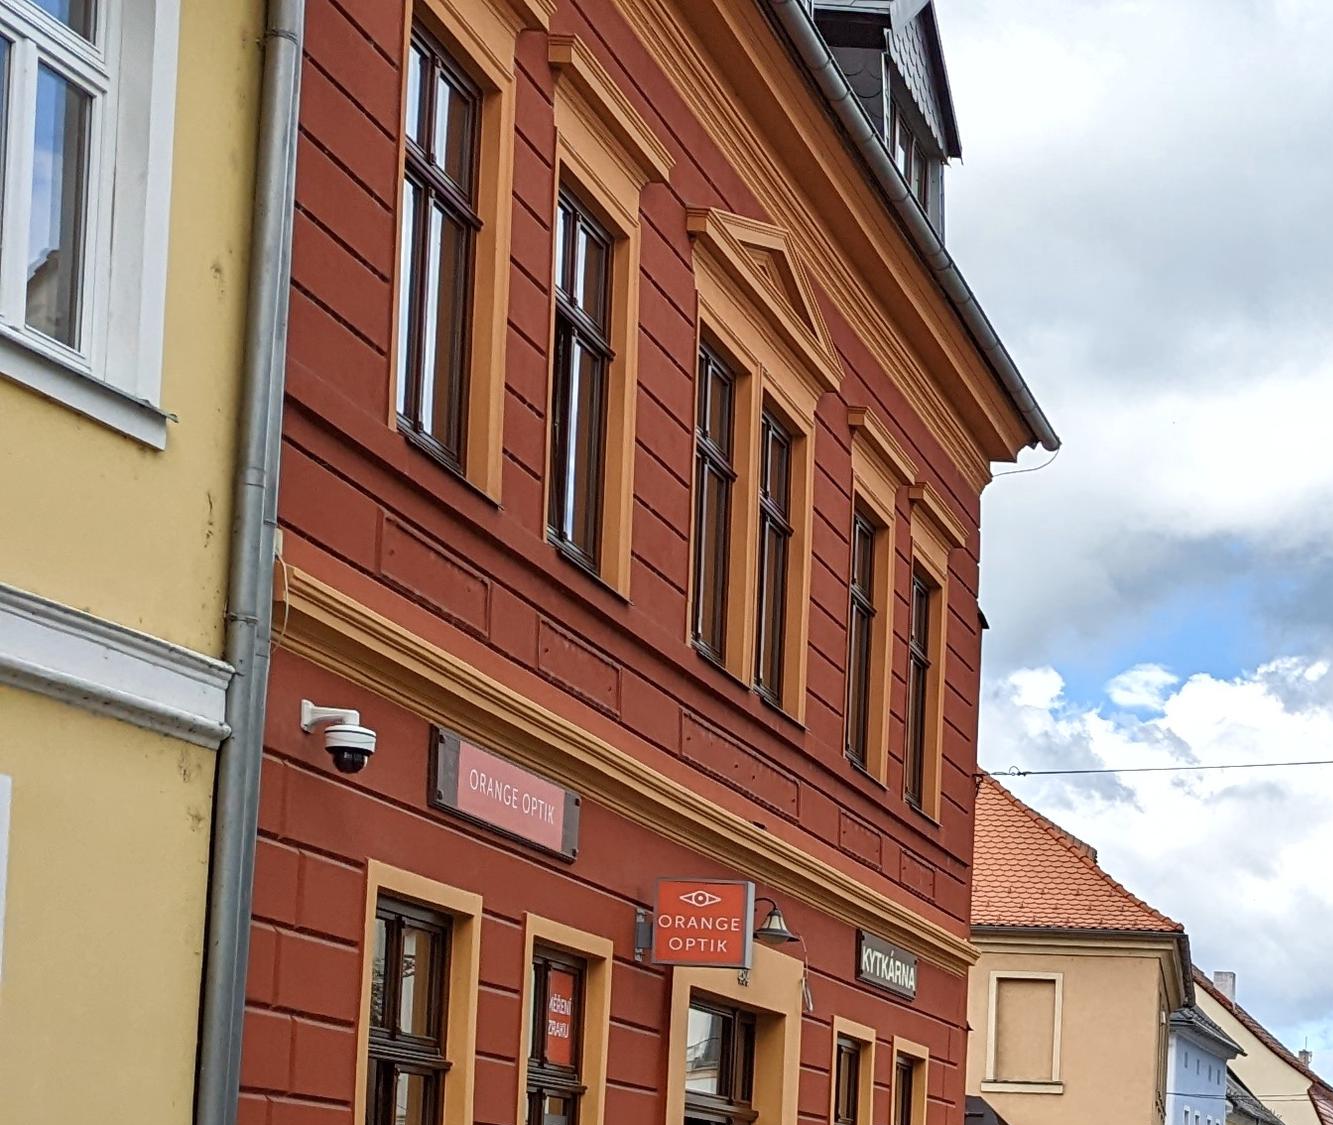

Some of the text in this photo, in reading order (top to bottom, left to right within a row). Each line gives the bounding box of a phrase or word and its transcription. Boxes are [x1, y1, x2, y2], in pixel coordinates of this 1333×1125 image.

[469, 769, 555, 825] ORANGE OPTIK
[658, 914, 741, 932] ORANGE
[668, 937, 728, 953] OPTIK
[862, 946, 916, 992] KYTKÁRNA
